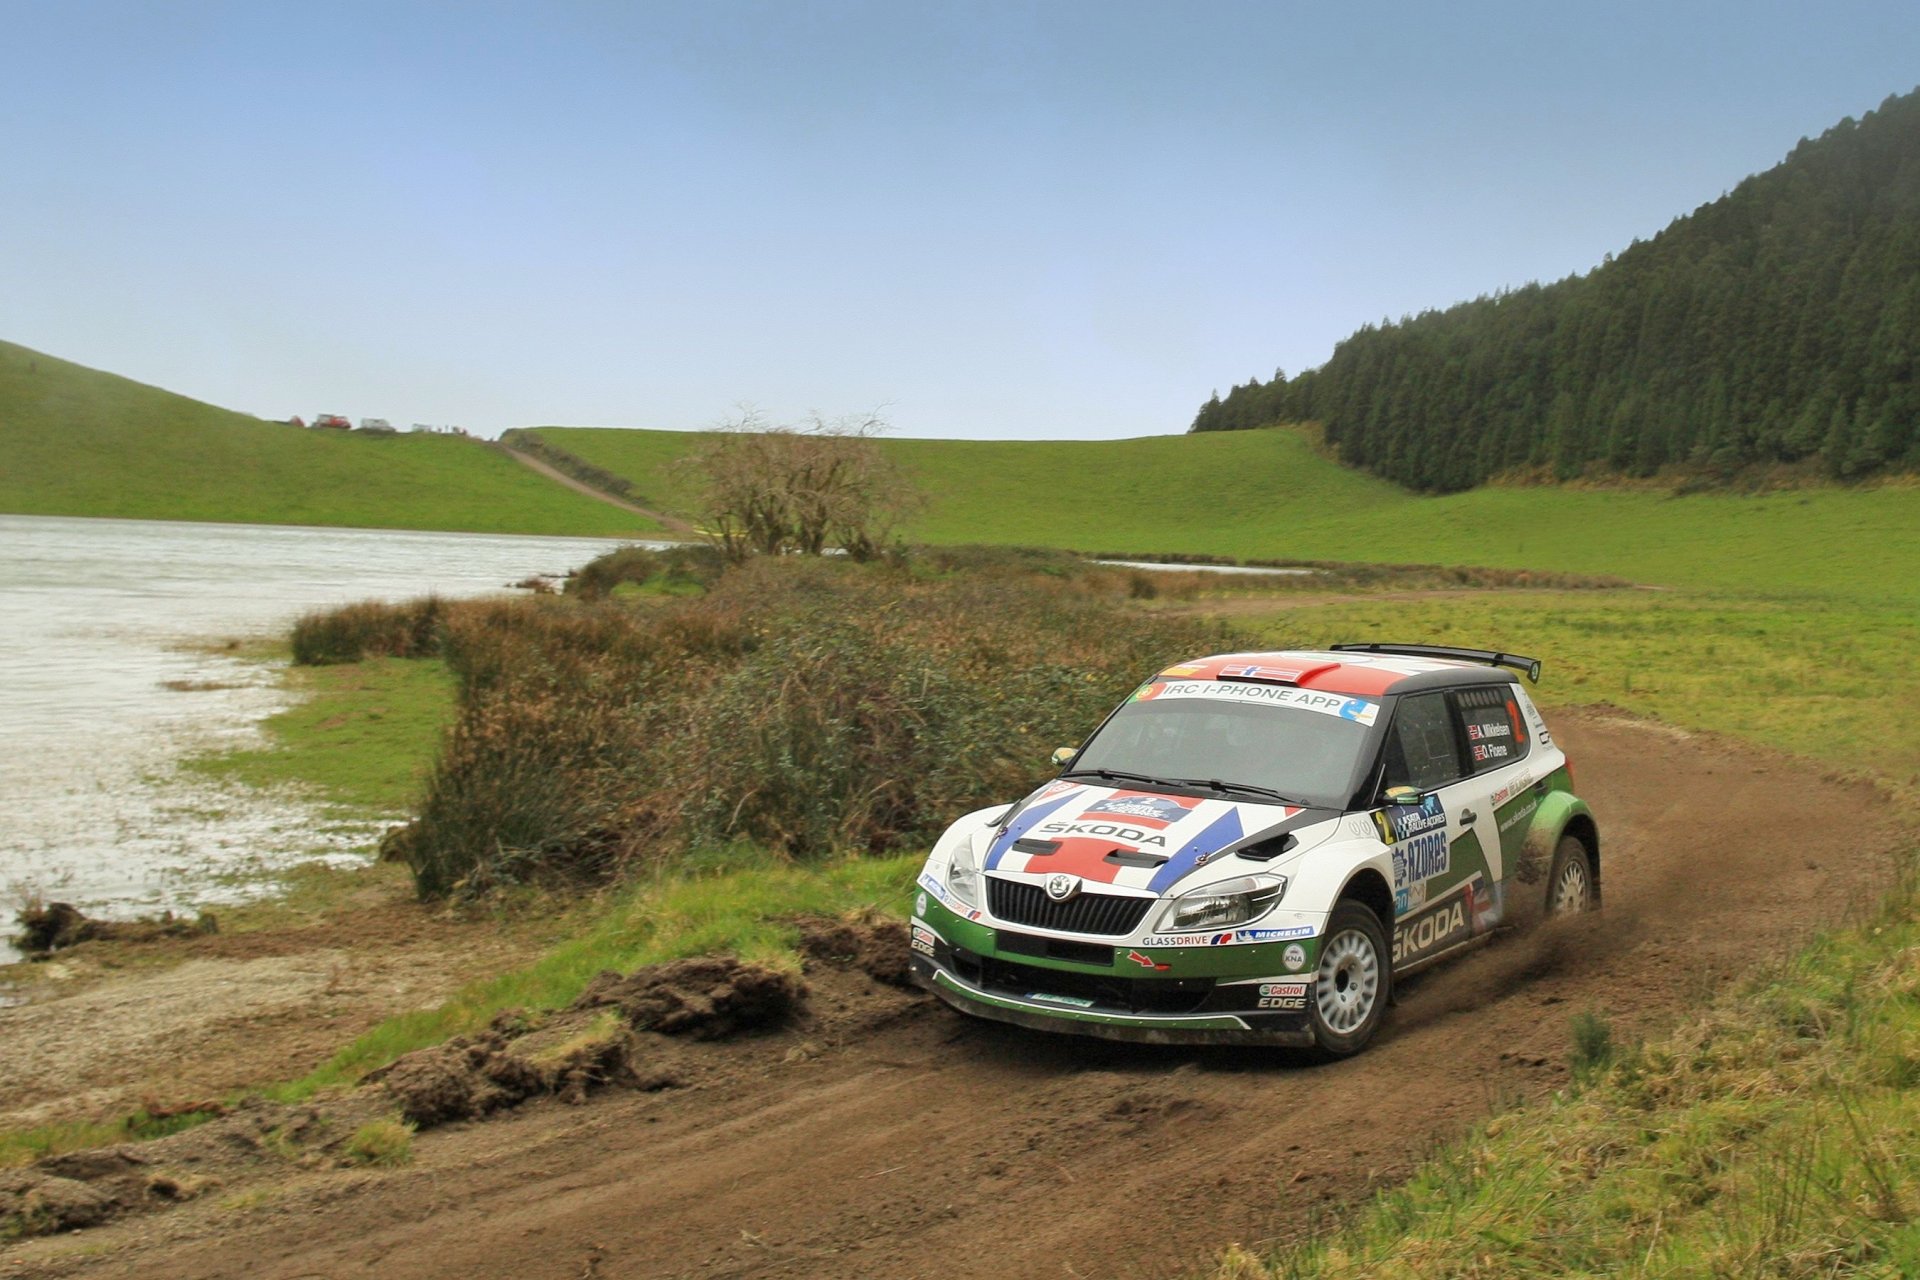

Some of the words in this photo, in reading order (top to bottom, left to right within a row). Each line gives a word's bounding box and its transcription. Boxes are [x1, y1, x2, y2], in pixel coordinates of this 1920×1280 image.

[1163, 684, 1200, 695] IRC
[1202, 684, 1293, 701] I-PHONE
[1295, 693, 1341, 709] APP
[1505, 698, 1526, 744] 2
[1039, 821, 1167, 848] ŠKODA
[1375, 810, 1397, 845] 2
[1142, 935, 1209, 946] GLASSDRIVE
[1254, 927, 1312, 939] MICHELIN
[1270, 985, 1304, 996] Castrol
[1257, 997, 1308, 1009] EDGE
